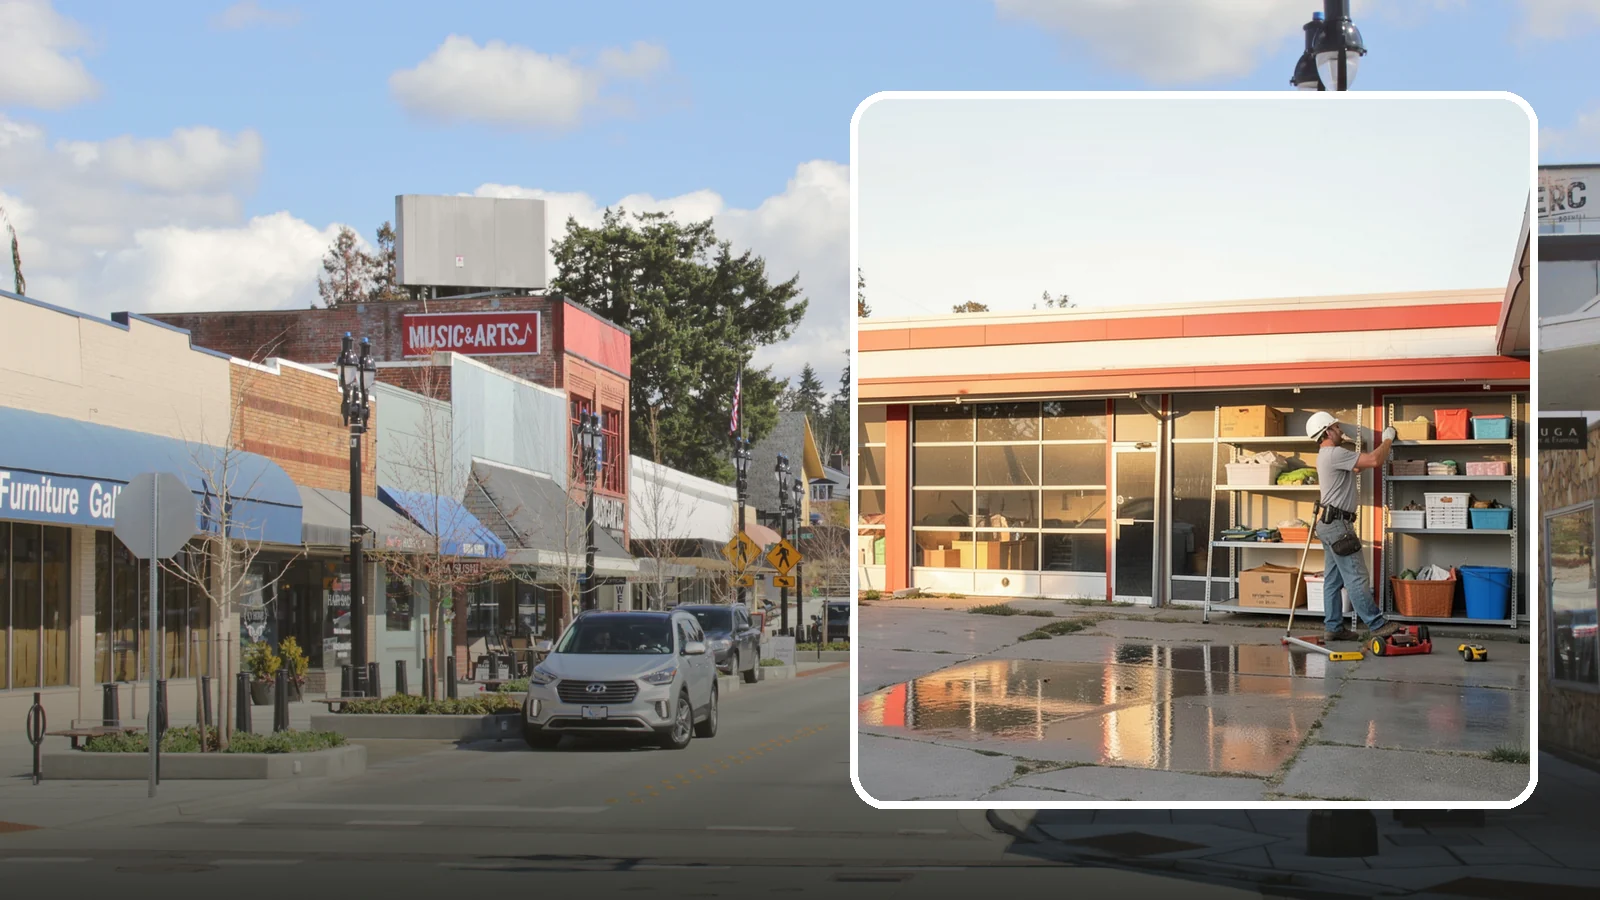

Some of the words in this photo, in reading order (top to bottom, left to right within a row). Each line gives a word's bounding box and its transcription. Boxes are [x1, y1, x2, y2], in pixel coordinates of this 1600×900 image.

[408, 322, 520, 349] MUSIC&ARTS
[1540, 427, 1578, 436] UGA
[0, 471, 80, 516] Furniture
[89, 482, 122, 519] Gal
